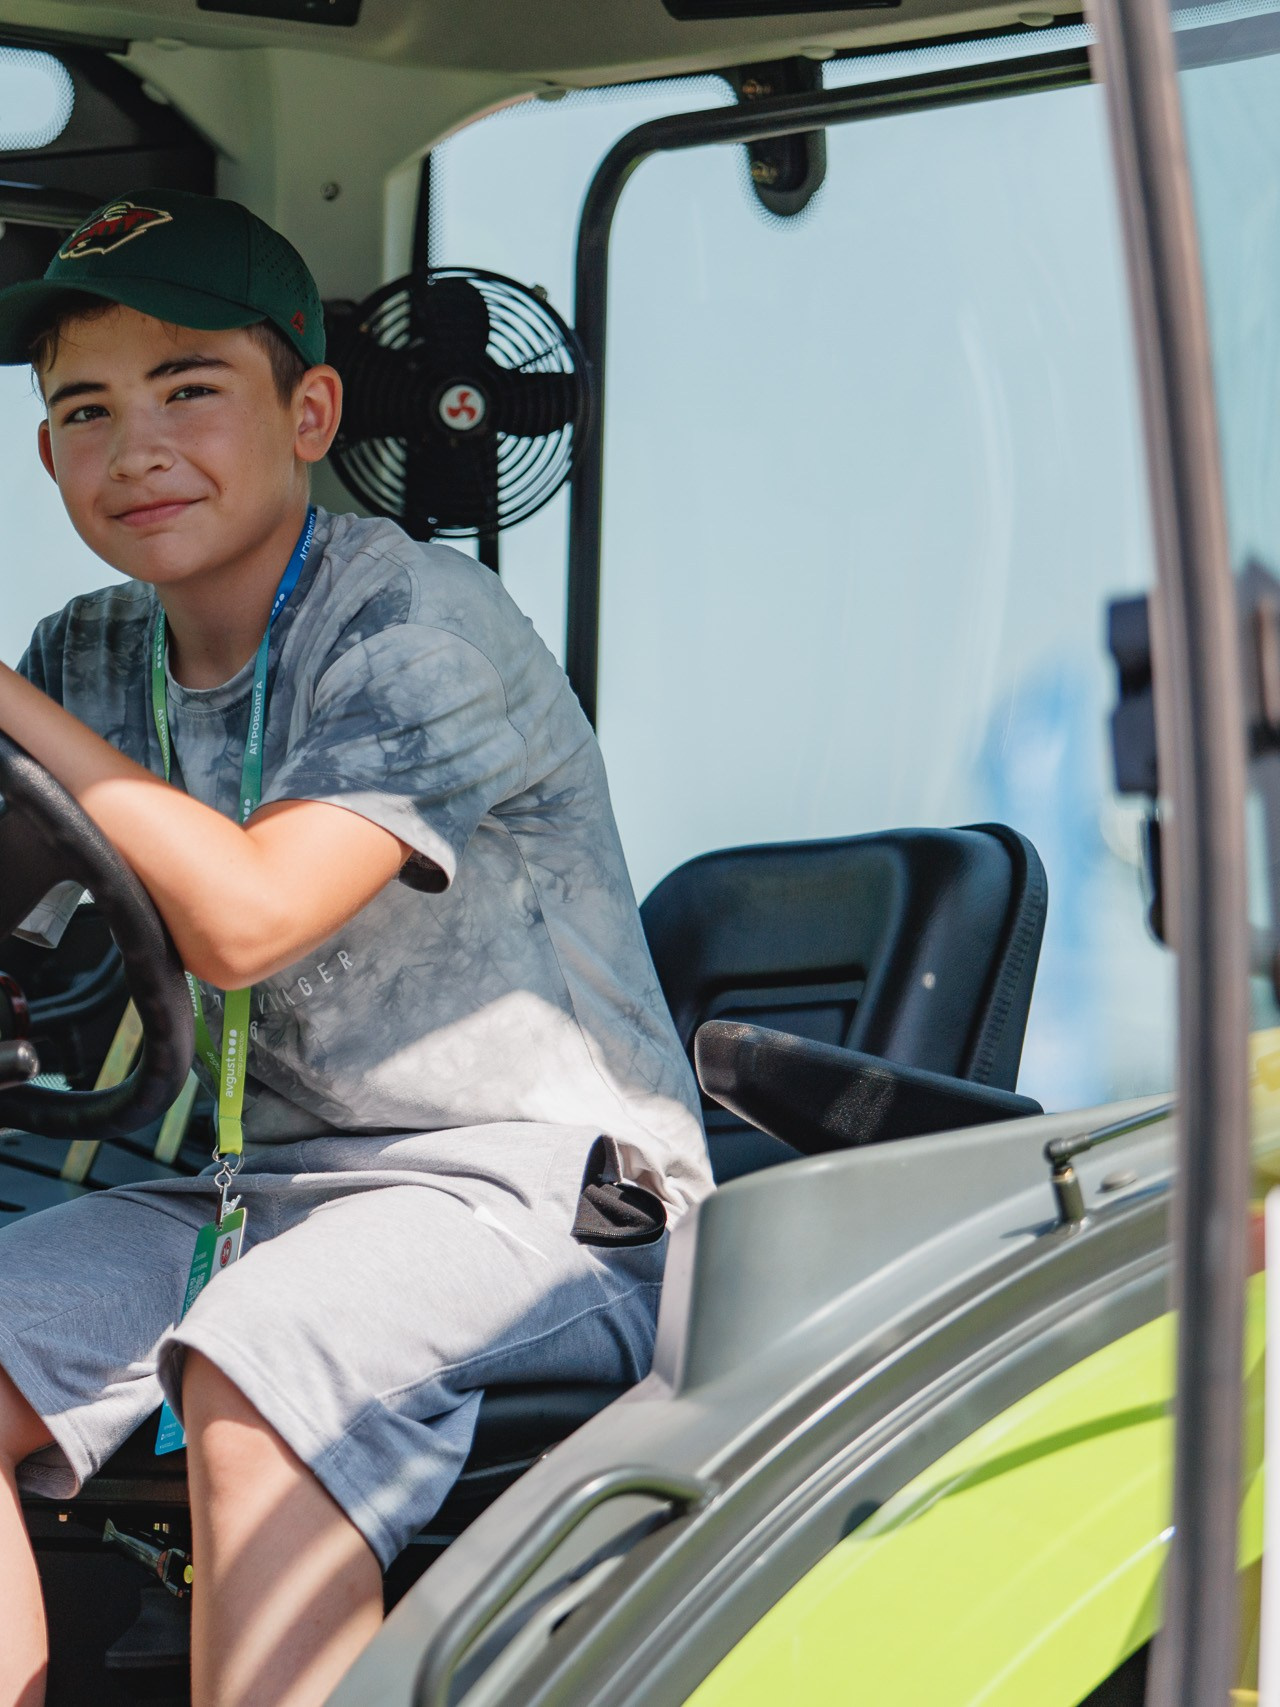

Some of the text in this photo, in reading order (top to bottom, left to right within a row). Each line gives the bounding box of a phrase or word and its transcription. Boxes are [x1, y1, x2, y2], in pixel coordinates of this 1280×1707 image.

[249, 681, 263, 755] АГРОВОЛГА
[237, 1030, 245, 1062] protection
[225, 1057, 237, 1098] avgust
